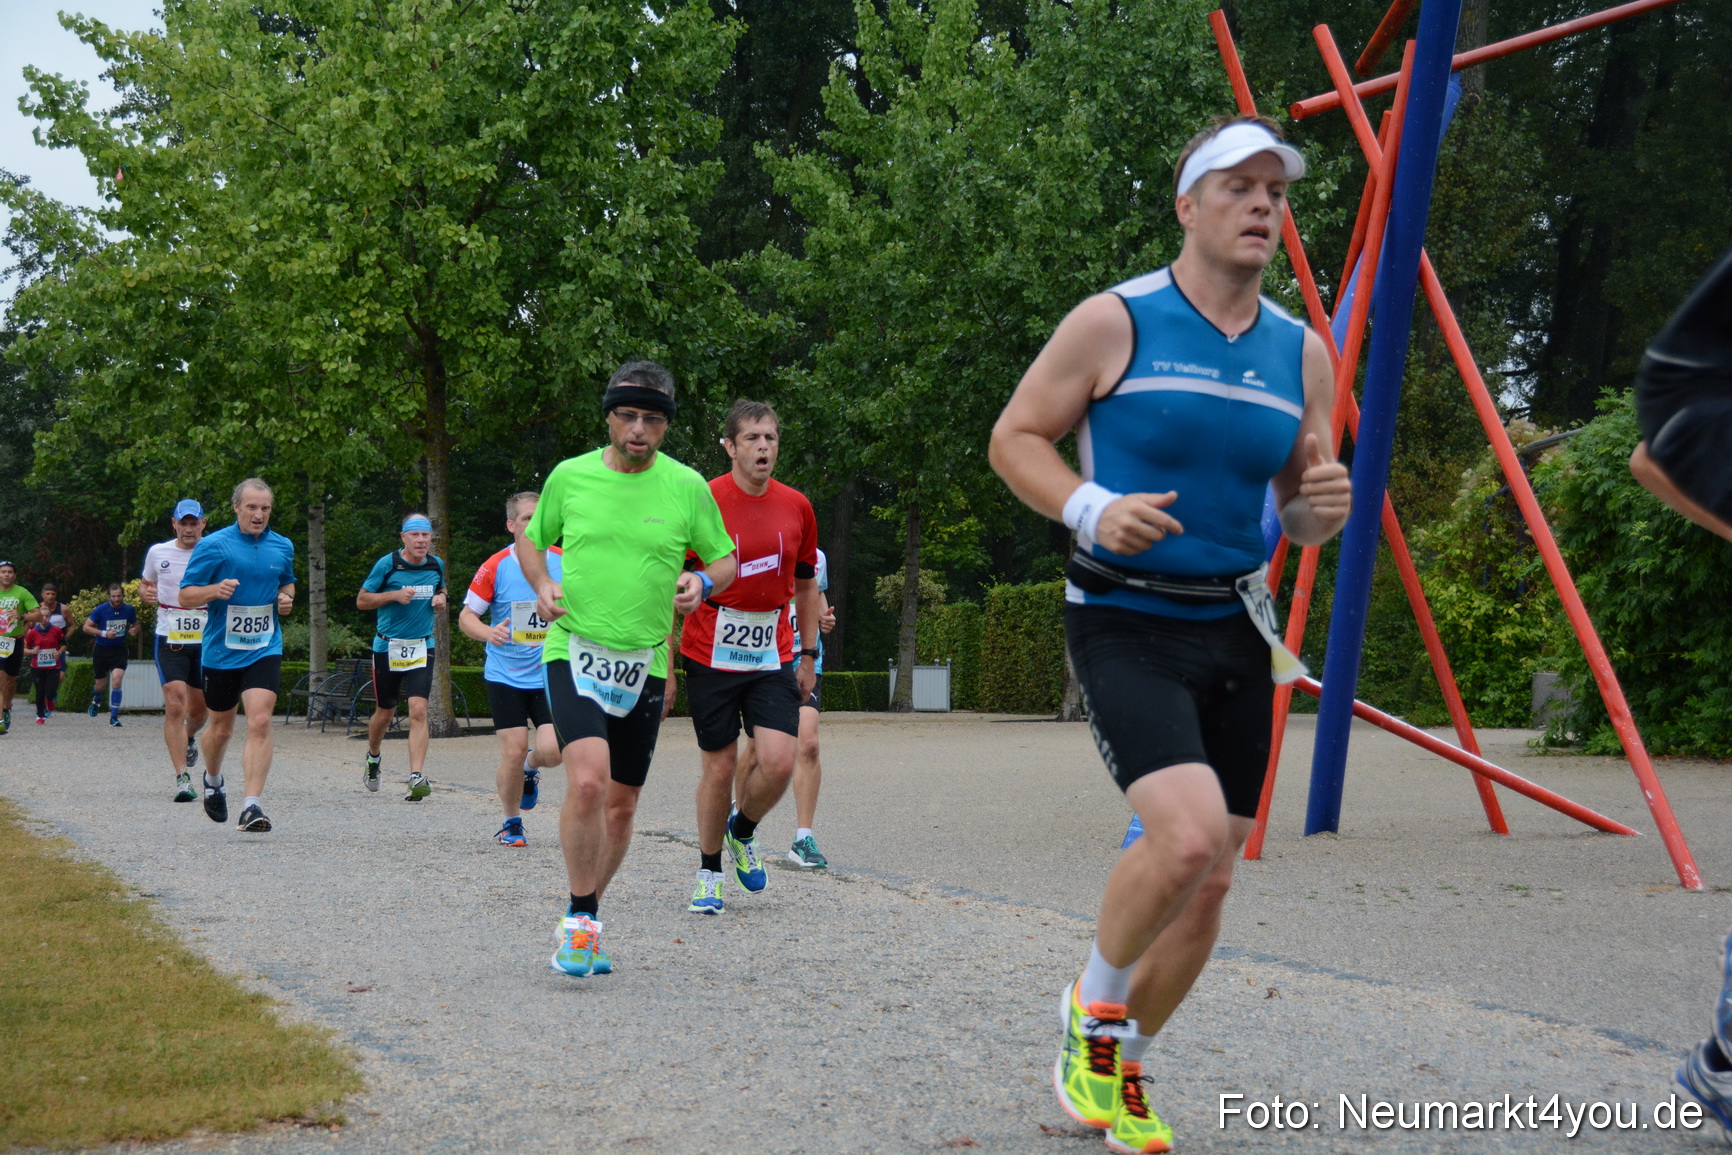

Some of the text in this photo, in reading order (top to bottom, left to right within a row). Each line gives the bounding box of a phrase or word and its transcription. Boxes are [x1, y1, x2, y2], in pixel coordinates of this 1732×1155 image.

[1152, 361, 1171, 371] TV
[751, 561, 769, 571] DEHN
[176, 617, 200, 631] 158
[232, 615, 270, 633] 2858
[722, 623, 774, 649] 2299
[401, 646, 416, 658] 87
[729, 651, 763, 664] Manfred
